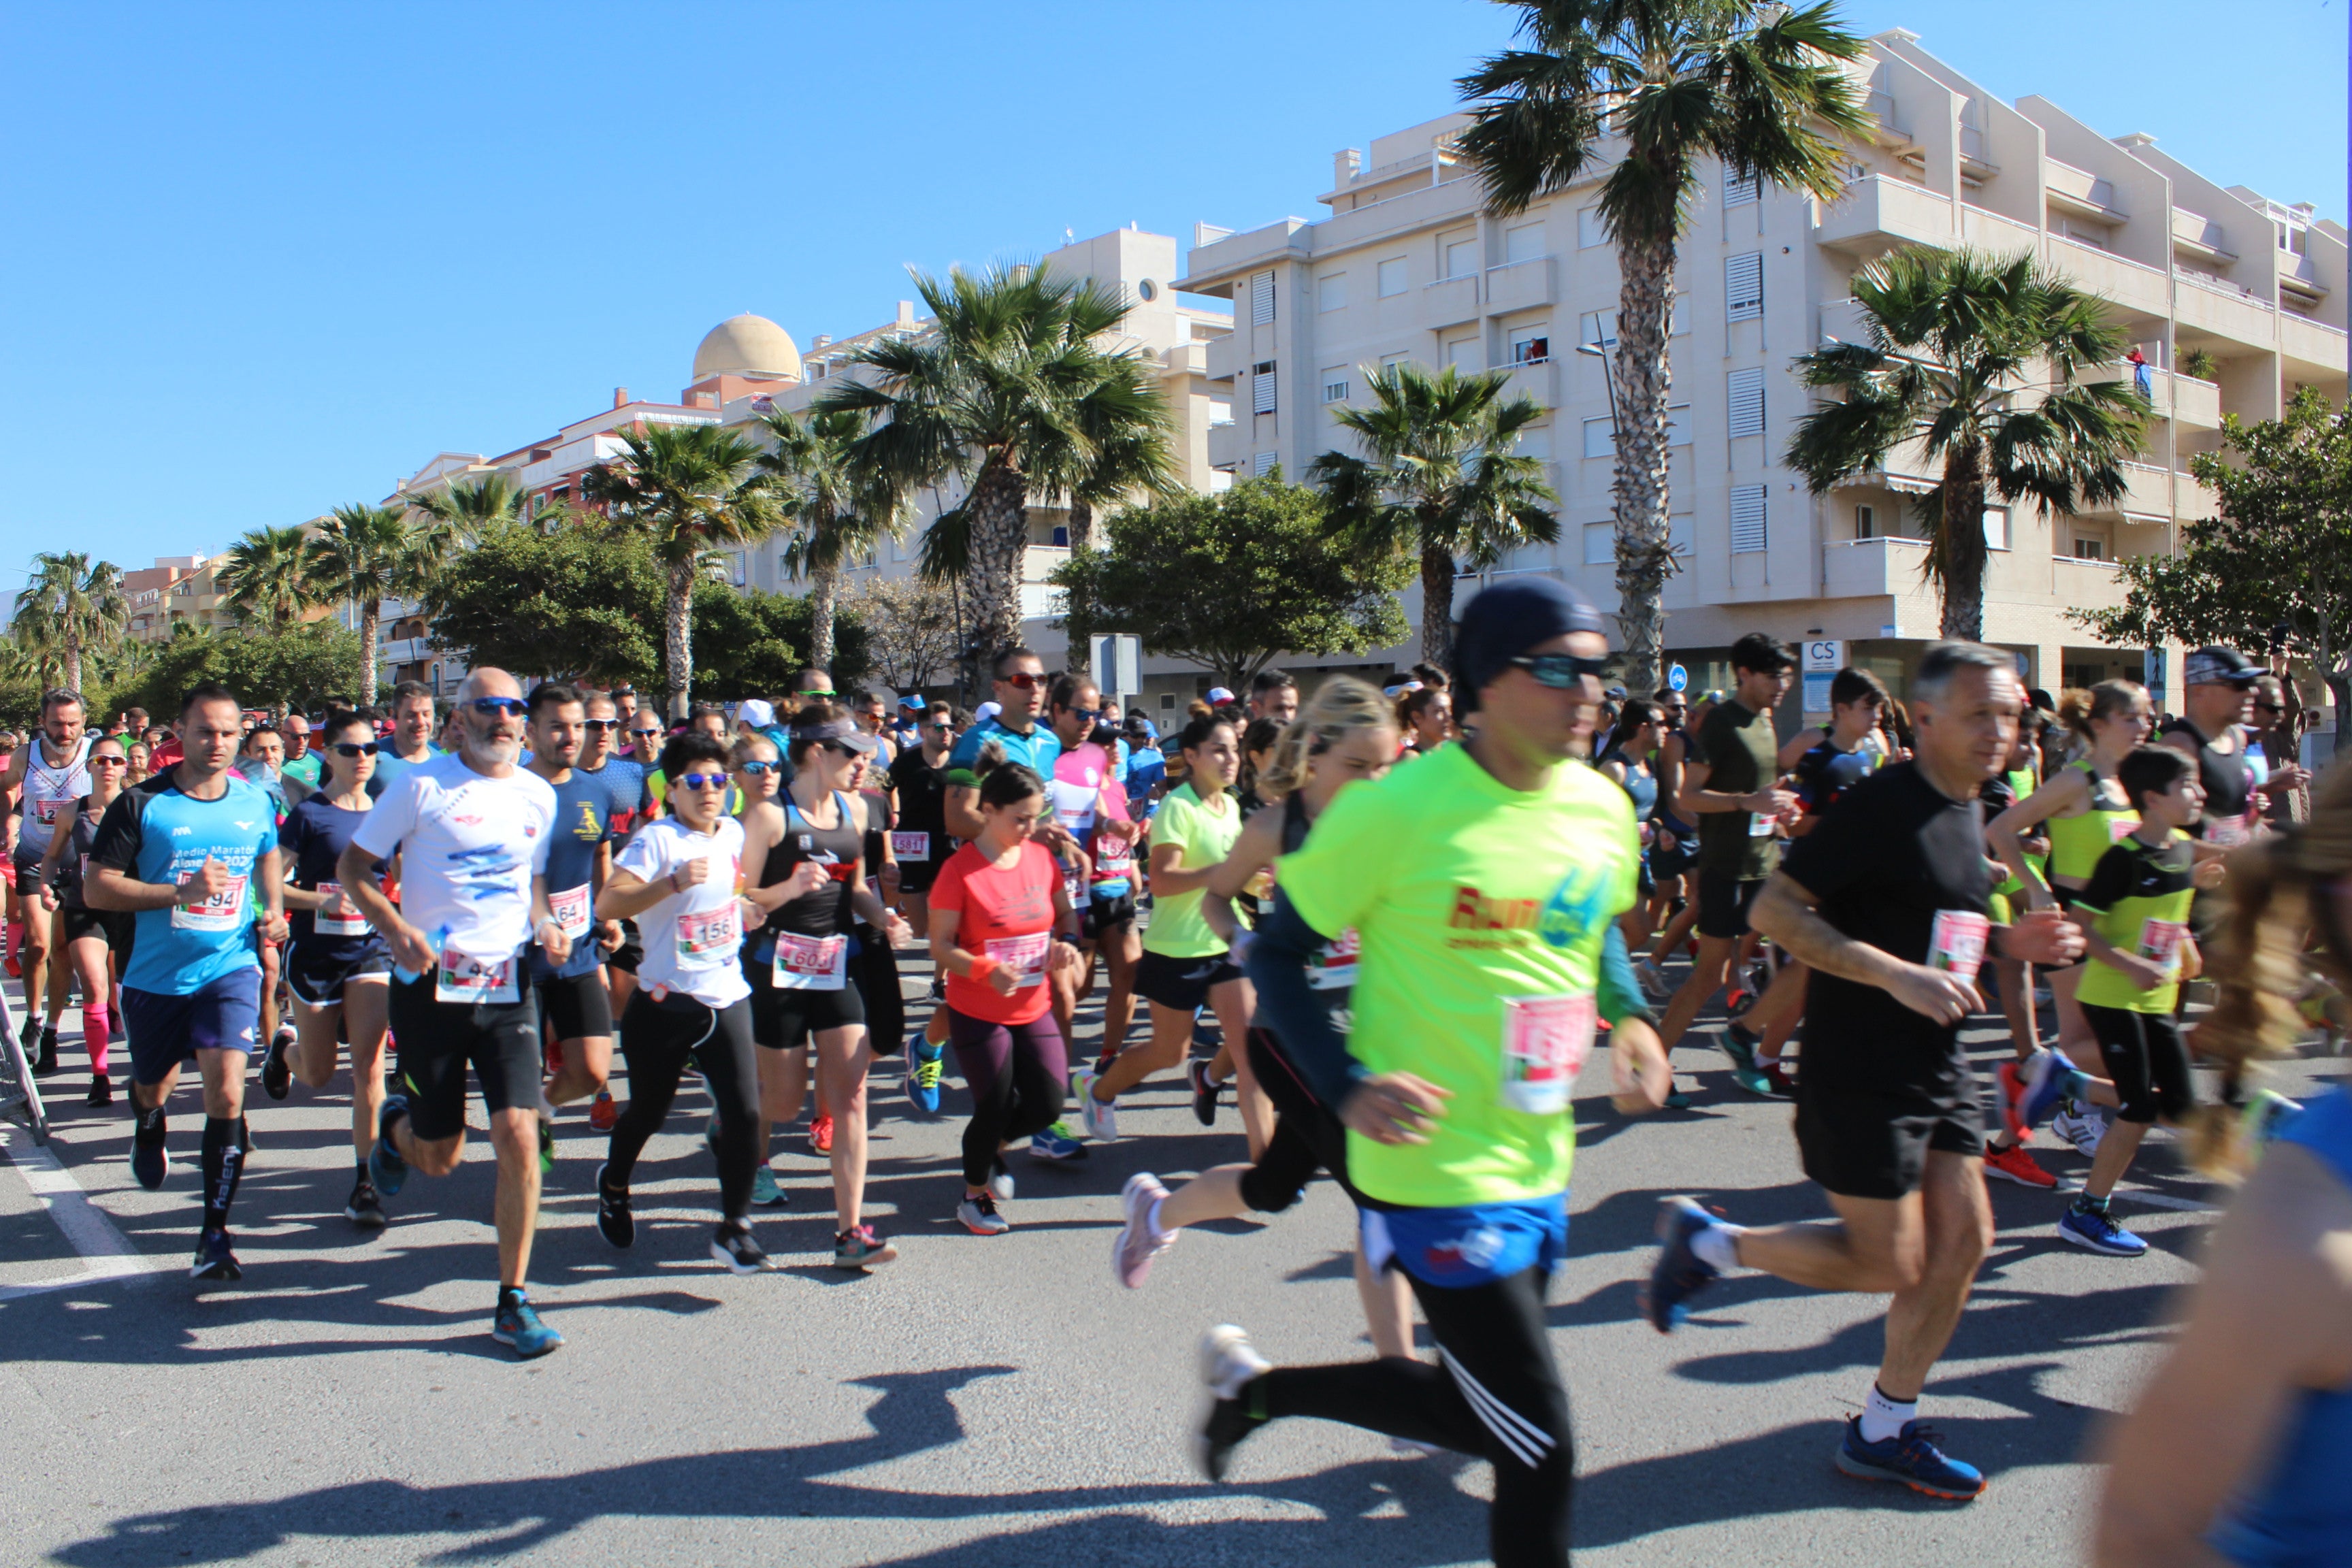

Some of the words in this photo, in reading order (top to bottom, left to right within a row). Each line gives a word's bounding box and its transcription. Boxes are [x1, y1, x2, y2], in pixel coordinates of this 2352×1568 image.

[1811, 642, 1834, 659] CS
[172, 847, 207, 859] Medio
[699, 919, 730, 941] 156
